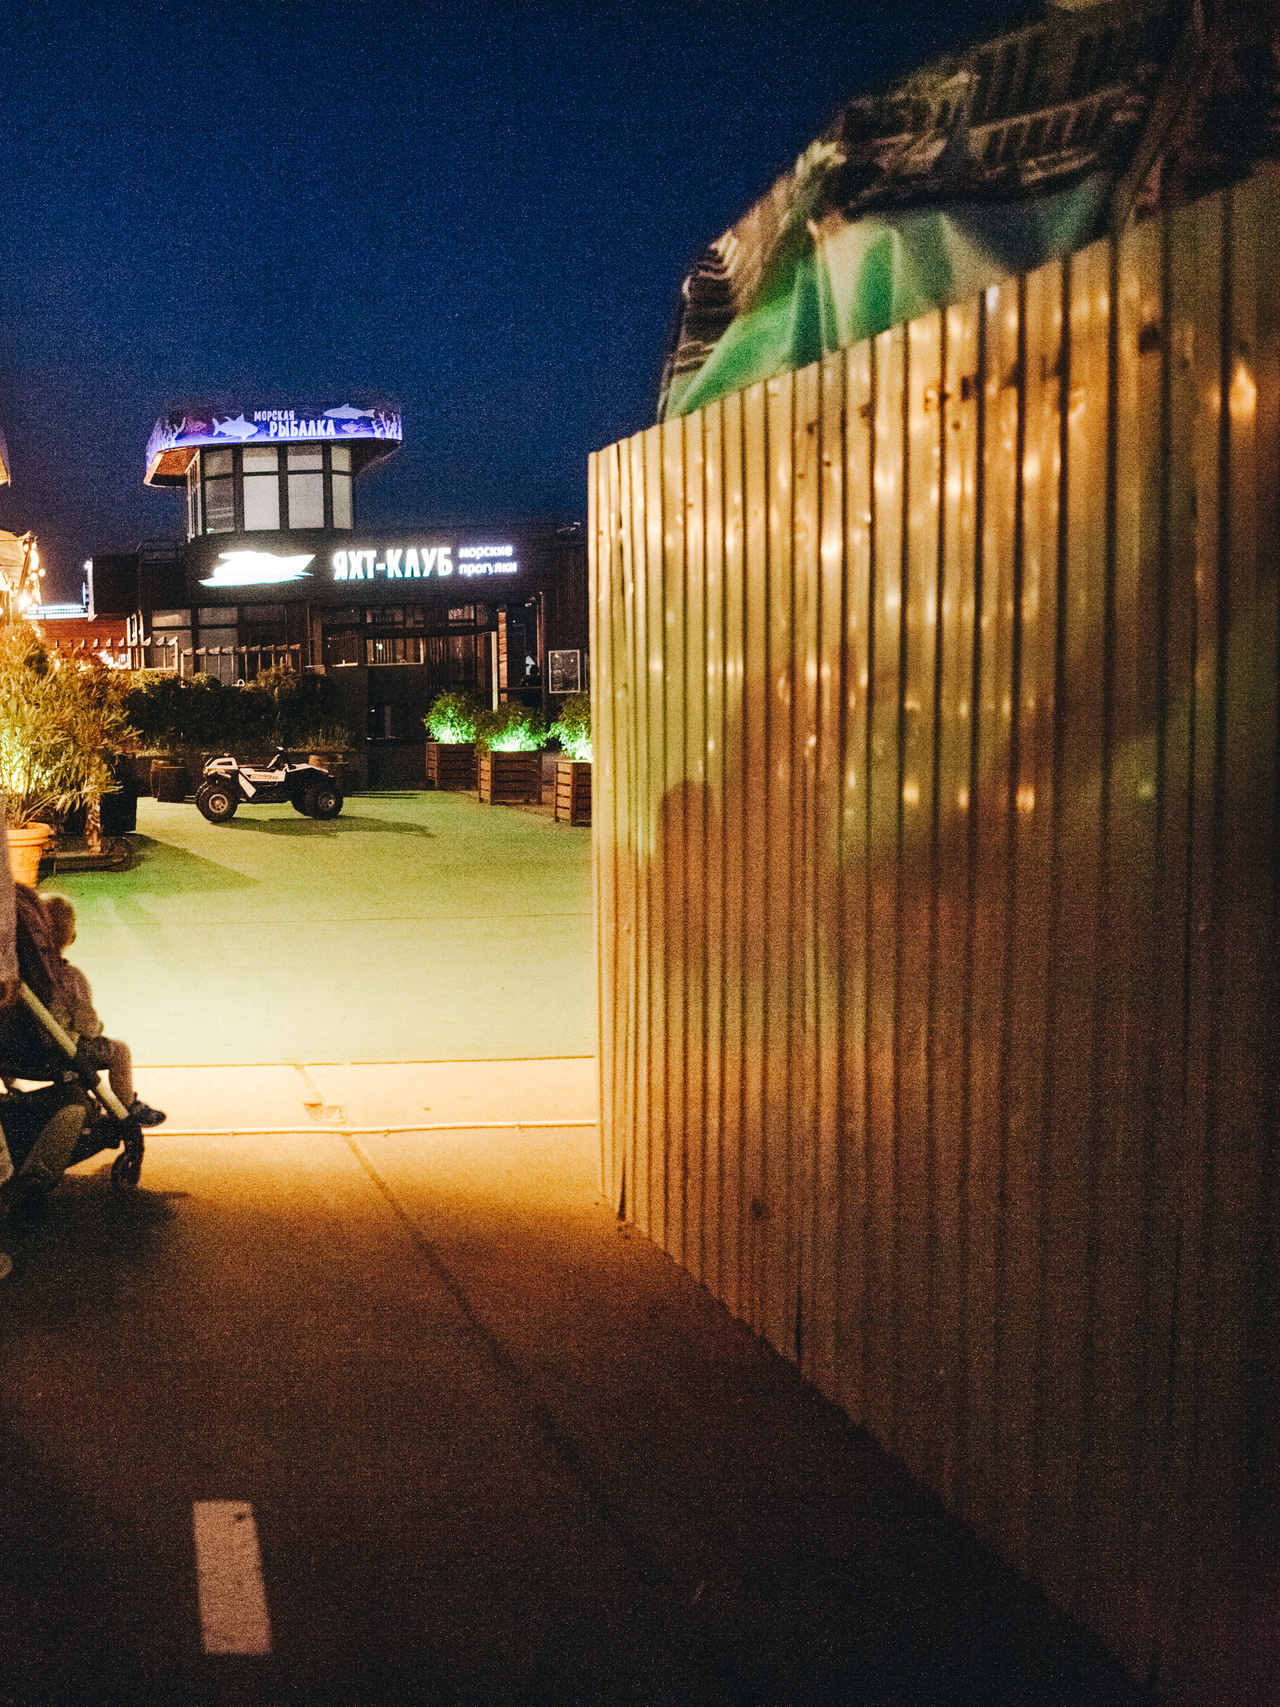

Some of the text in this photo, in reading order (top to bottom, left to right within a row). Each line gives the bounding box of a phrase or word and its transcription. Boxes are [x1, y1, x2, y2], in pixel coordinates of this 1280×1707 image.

[254, 410, 295, 422] МОРСКАЯ
[269, 420, 336, 437] РЫБАЛКА
[459, 545, 514, 560] морские
[333, 547, 453, 581] ЯХТ-КЛУБ
[459, 562, 518, 577] прогулки
